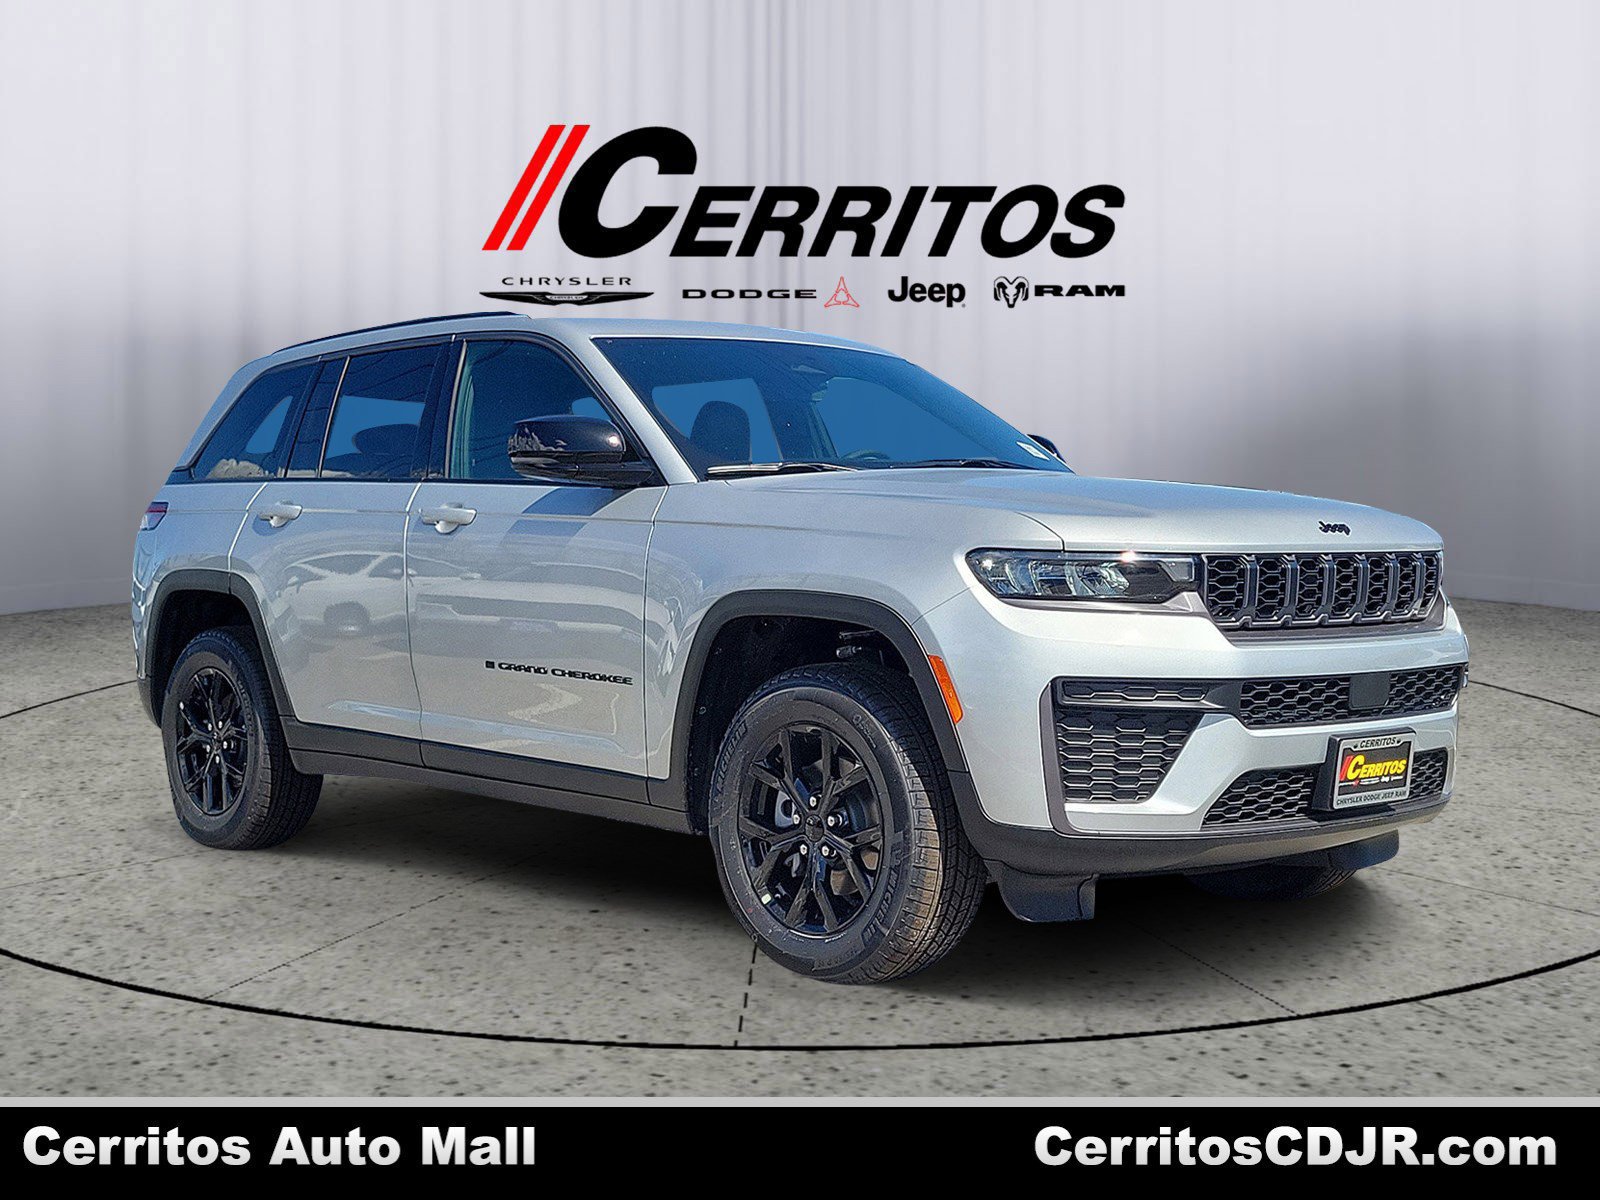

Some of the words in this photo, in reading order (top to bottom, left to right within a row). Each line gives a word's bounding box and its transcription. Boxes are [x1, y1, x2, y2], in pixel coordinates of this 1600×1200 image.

[1319, 521, 1350, 536] Jeep
[498, 662, 548, 675] GRAND
[551, 668, 634, 686] CHEROKEE
[1360, 737, 1397, 748] CERRITOS
[1346, 755, 1407, 780] CERRITOS
[1336, 795, 1363, 806] CHRYSLER
[1364, 793, 1381, 801] DODGE
